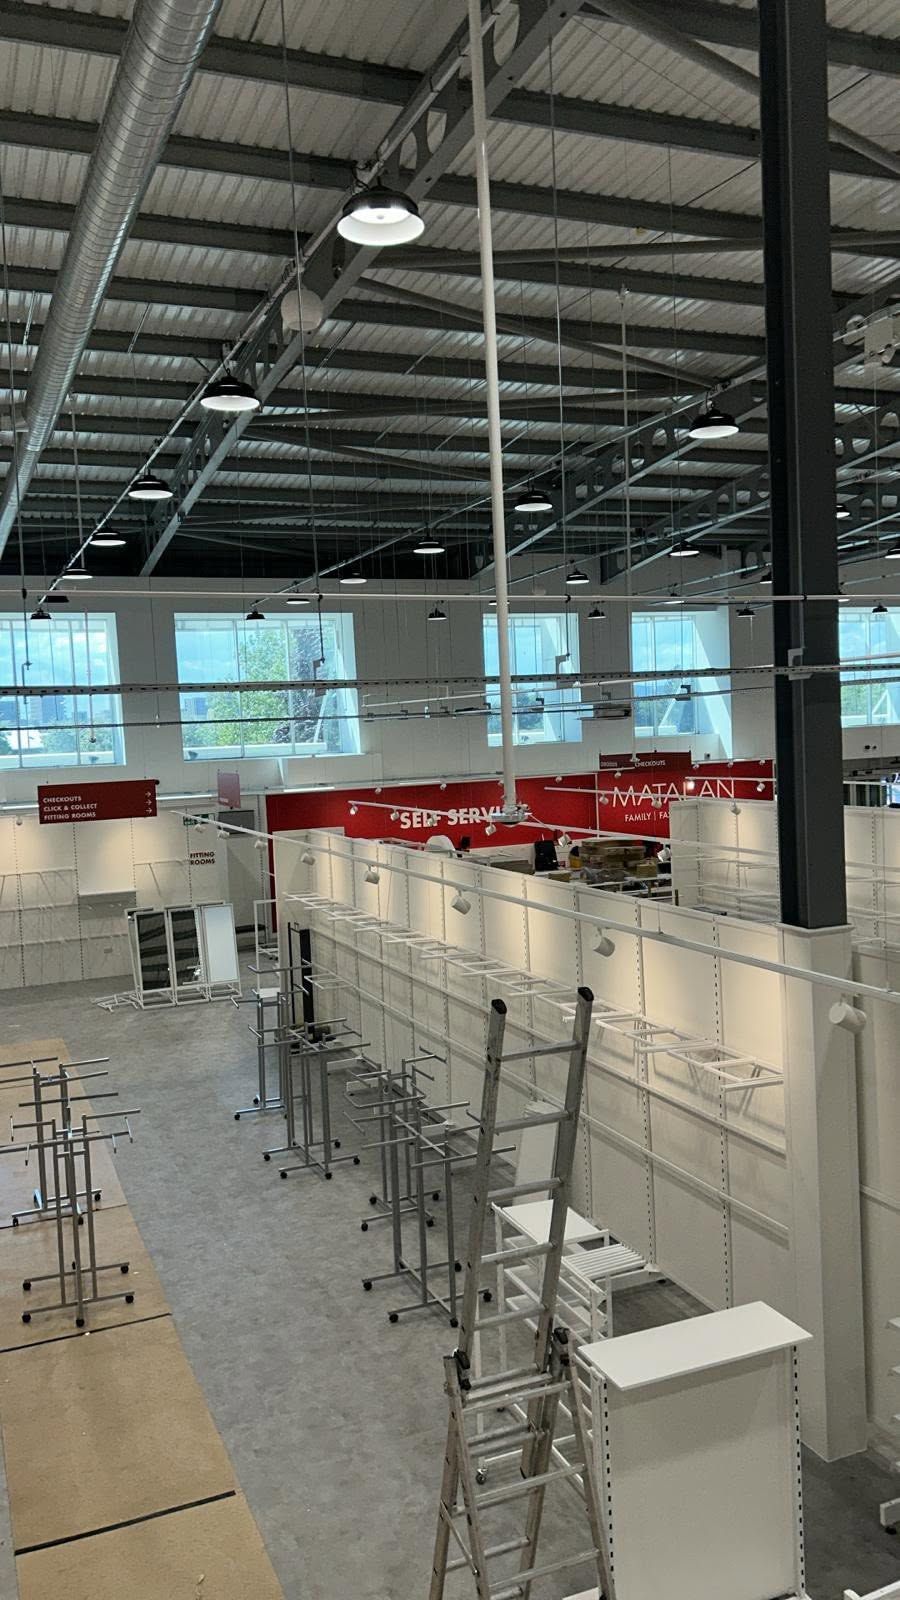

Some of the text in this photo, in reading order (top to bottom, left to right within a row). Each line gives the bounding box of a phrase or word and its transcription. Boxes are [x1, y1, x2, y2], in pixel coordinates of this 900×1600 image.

[634, 760, 666, 768] CHECKOUTS
[612, 779, 735, 808] MATALAN
[42, 795, 82, 803] CHECKOUTS
[70, 803, 97, 811] COLLECT
[71, 811, 97, 819] ROOMS
[624, 812, 652, 822] FAMILY
[400, 810, 442, 830] SELF
[189, 851, 215, 859] FITTING
[190, 858, 215, 866] ROOMS
